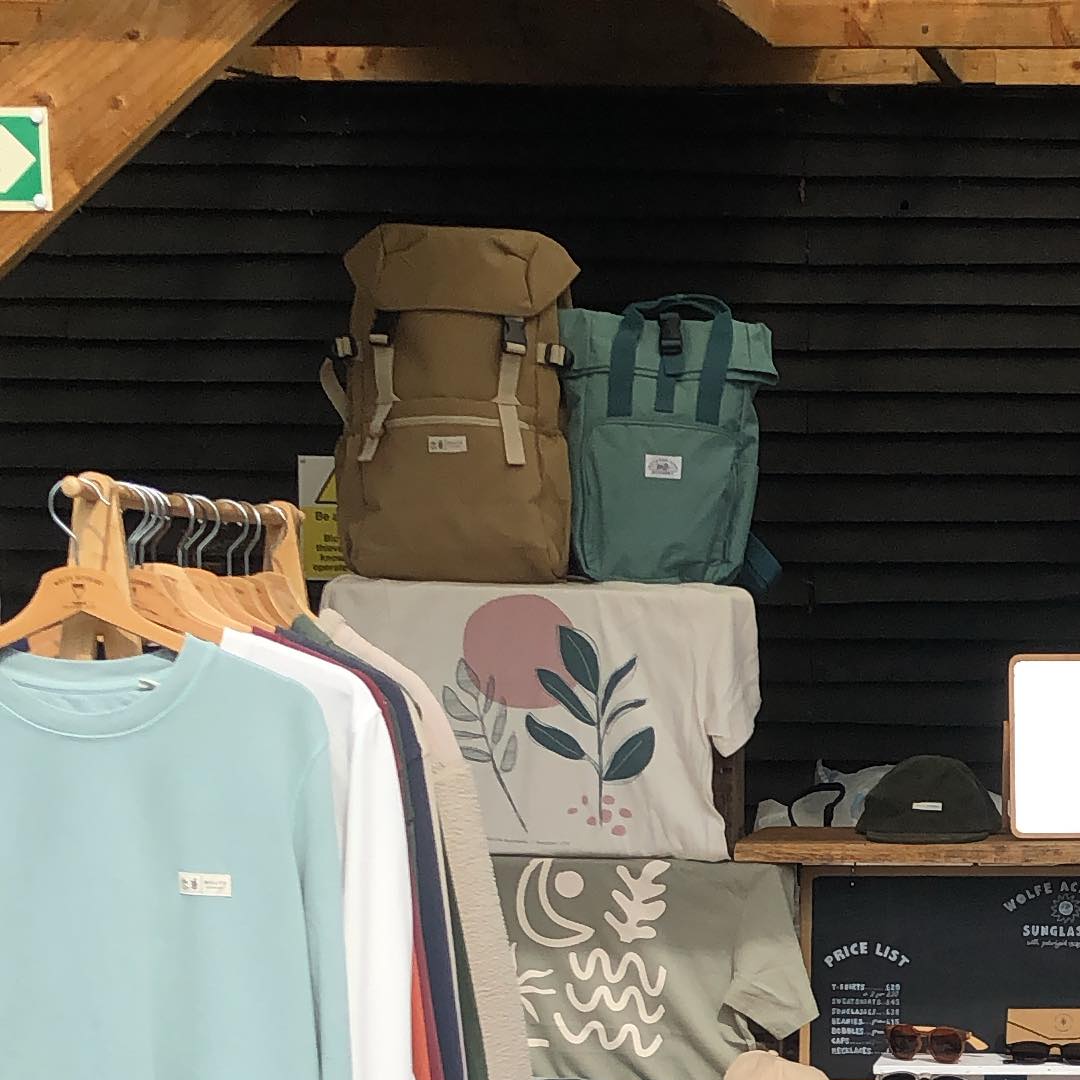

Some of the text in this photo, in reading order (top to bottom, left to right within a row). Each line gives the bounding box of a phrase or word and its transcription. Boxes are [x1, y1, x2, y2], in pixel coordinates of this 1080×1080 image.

[1003, 882, 1053, 913] WOLFE
[823, 942, 910, 968] PRICE LIST
